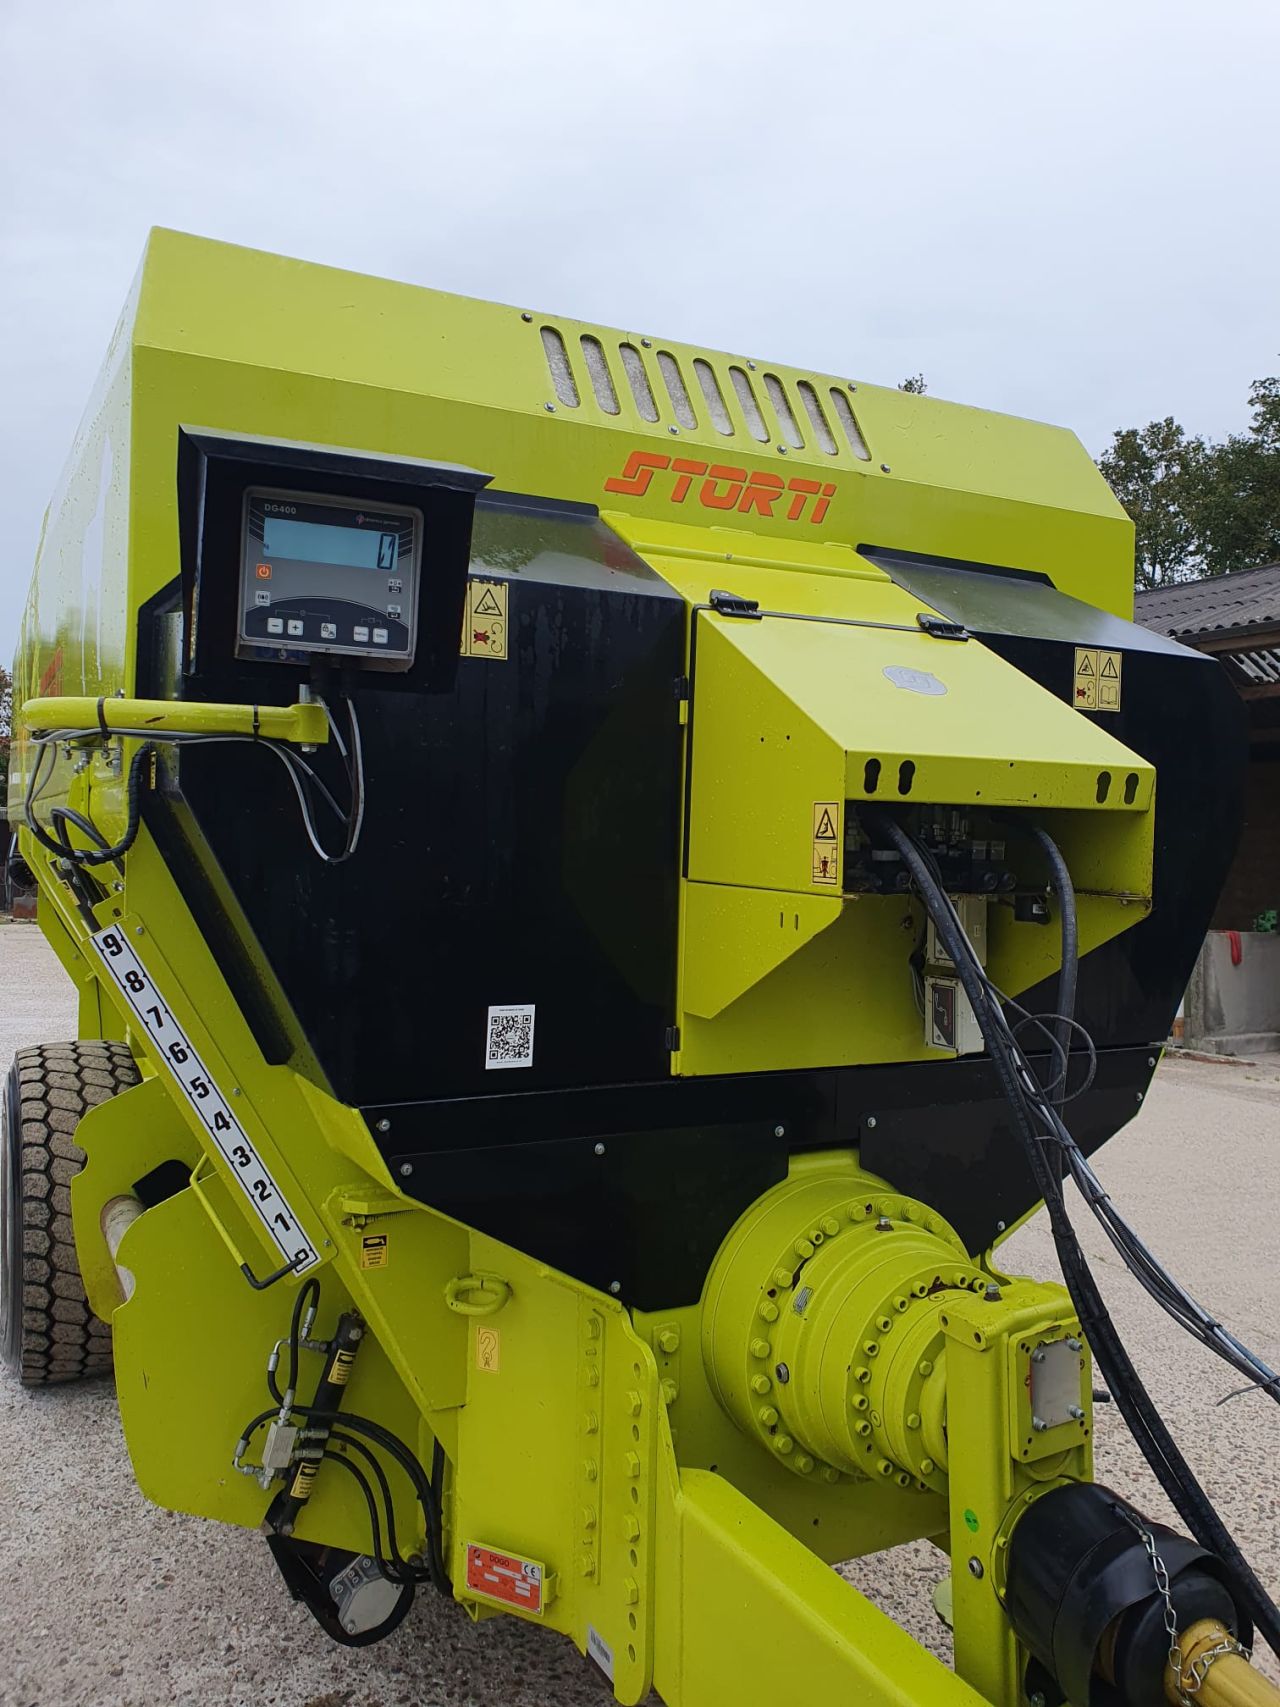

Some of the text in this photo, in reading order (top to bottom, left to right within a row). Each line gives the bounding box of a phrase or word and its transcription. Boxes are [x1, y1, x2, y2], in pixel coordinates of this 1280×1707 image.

[264, 503, 297, 514] DG400
[377, 533, 396, 569] 0
[102, 933, 123, 957] 9
[125, 970, 145, 993] 8
[146, 1005, 164, 1028] 7
[168, 1041, 188, 1064] 6
[189, 1076, 210, 1099] 5
[213, 1111, 232, 1132] 4
[232, 1145, 251, 1167] 3
[253, 1179, 272, 1202] 2
[274, 1212, 291, 1232] 1
[523, 1564, 536, 1577] CE
